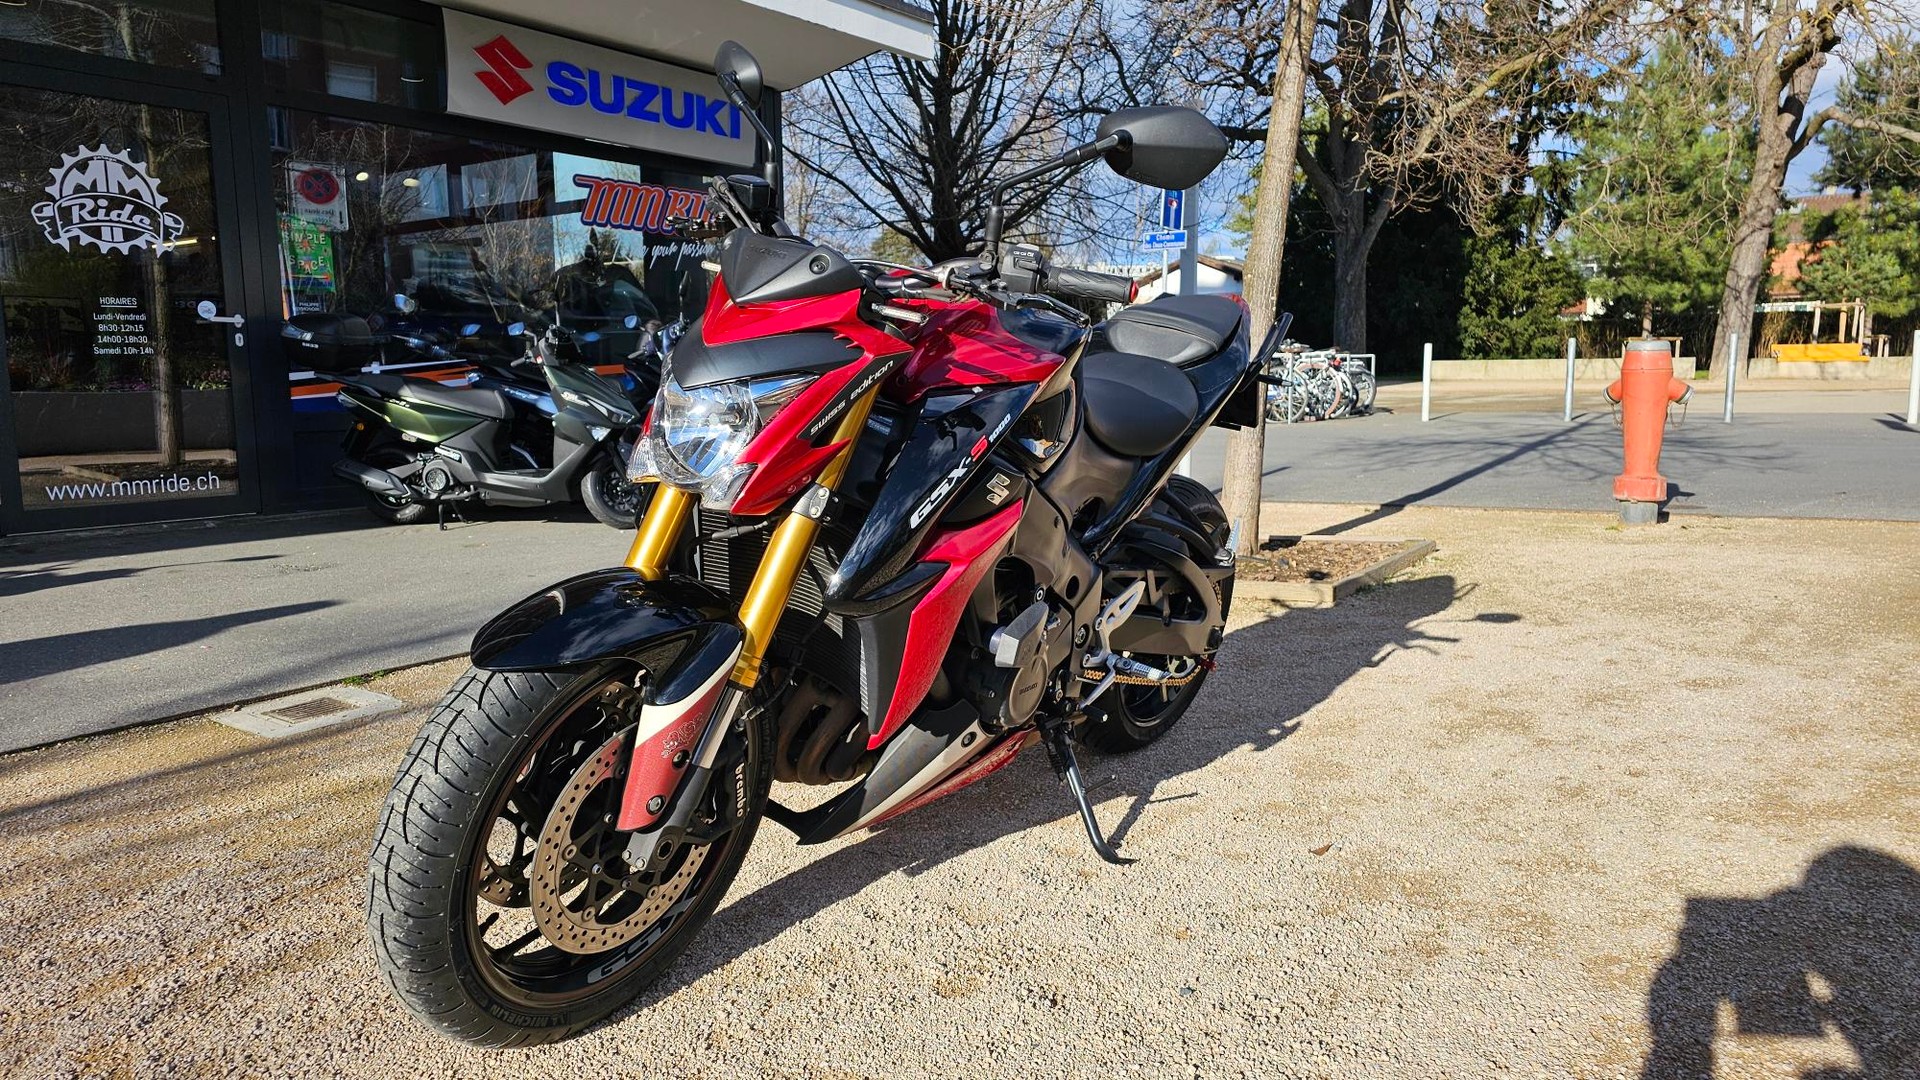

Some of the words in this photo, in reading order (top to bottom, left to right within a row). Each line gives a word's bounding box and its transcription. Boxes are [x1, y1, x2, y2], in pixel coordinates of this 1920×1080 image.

[546, 61, 741, 140] SUZUKI
[61, 198, 154, 230] Ride
[573, 174, 666, 231] MM
[93, 312, 147, 320] Lundi-Vendredi
[99, 296, 137, 306] HORAIRES
[97, 335, 148, 343] 14h00-18h30
[98, 324, 144, 332] 8h30-12h15
[93, 346, 121, 354] Samedi
[123, 346, 154, 354] 10h-14h
[850, 360, 894, 400] edition
[988, 413, 1011, 443] 1000
[45, 471, 220, 501] www.mmride.ch
[735, 762, 747, 818] brembo
